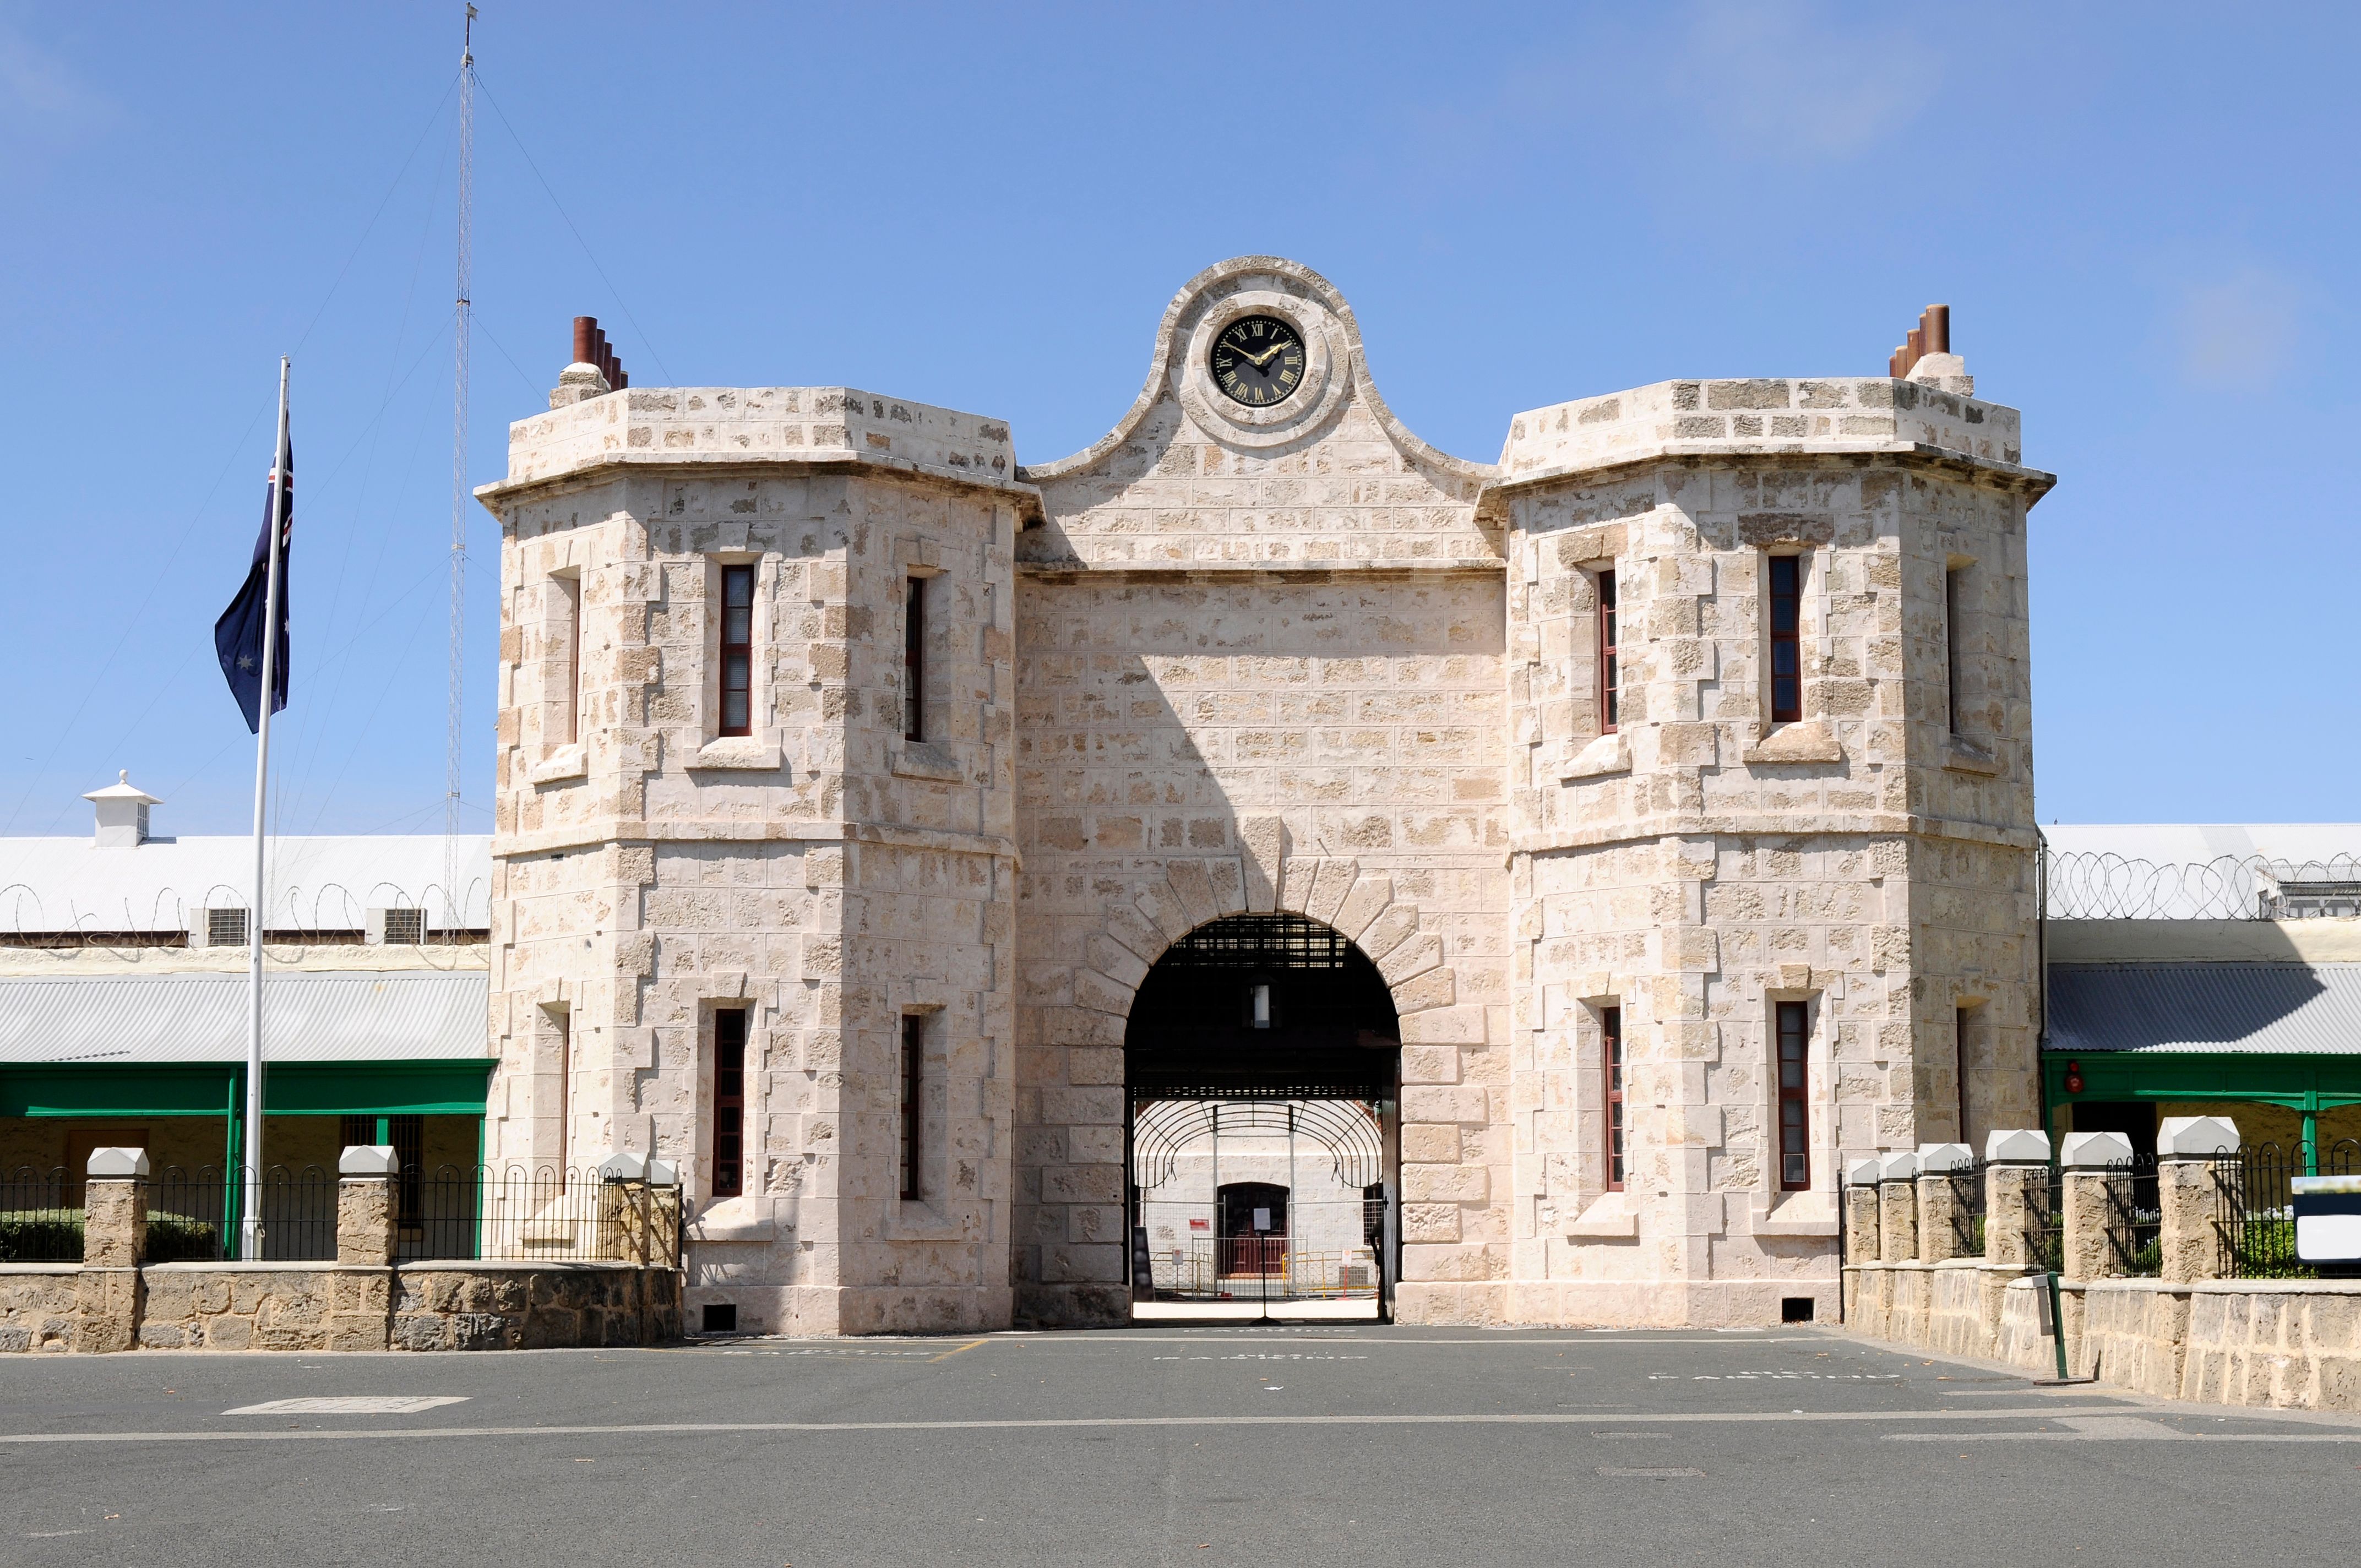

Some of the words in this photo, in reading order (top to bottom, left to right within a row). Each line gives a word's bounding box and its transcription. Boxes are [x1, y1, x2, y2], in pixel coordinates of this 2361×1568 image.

[1234, 328, 1248, 343] XI
[1252, 324, 1264, 337] XII
[1270, 328, 1279, 340] I
[1281, 339, 1293, 350] II
[1219, 358, 1232, 367] IX
[1285, 356, 1298, 365] III
[1222, 370, 1238, 388] VIII
[1279, 369, 1295, 385] IIII
[1234, 383, 1248, 398] VII
[1255, 387, 1264, 400] VI
[1271, 383, 1282, 396] V
